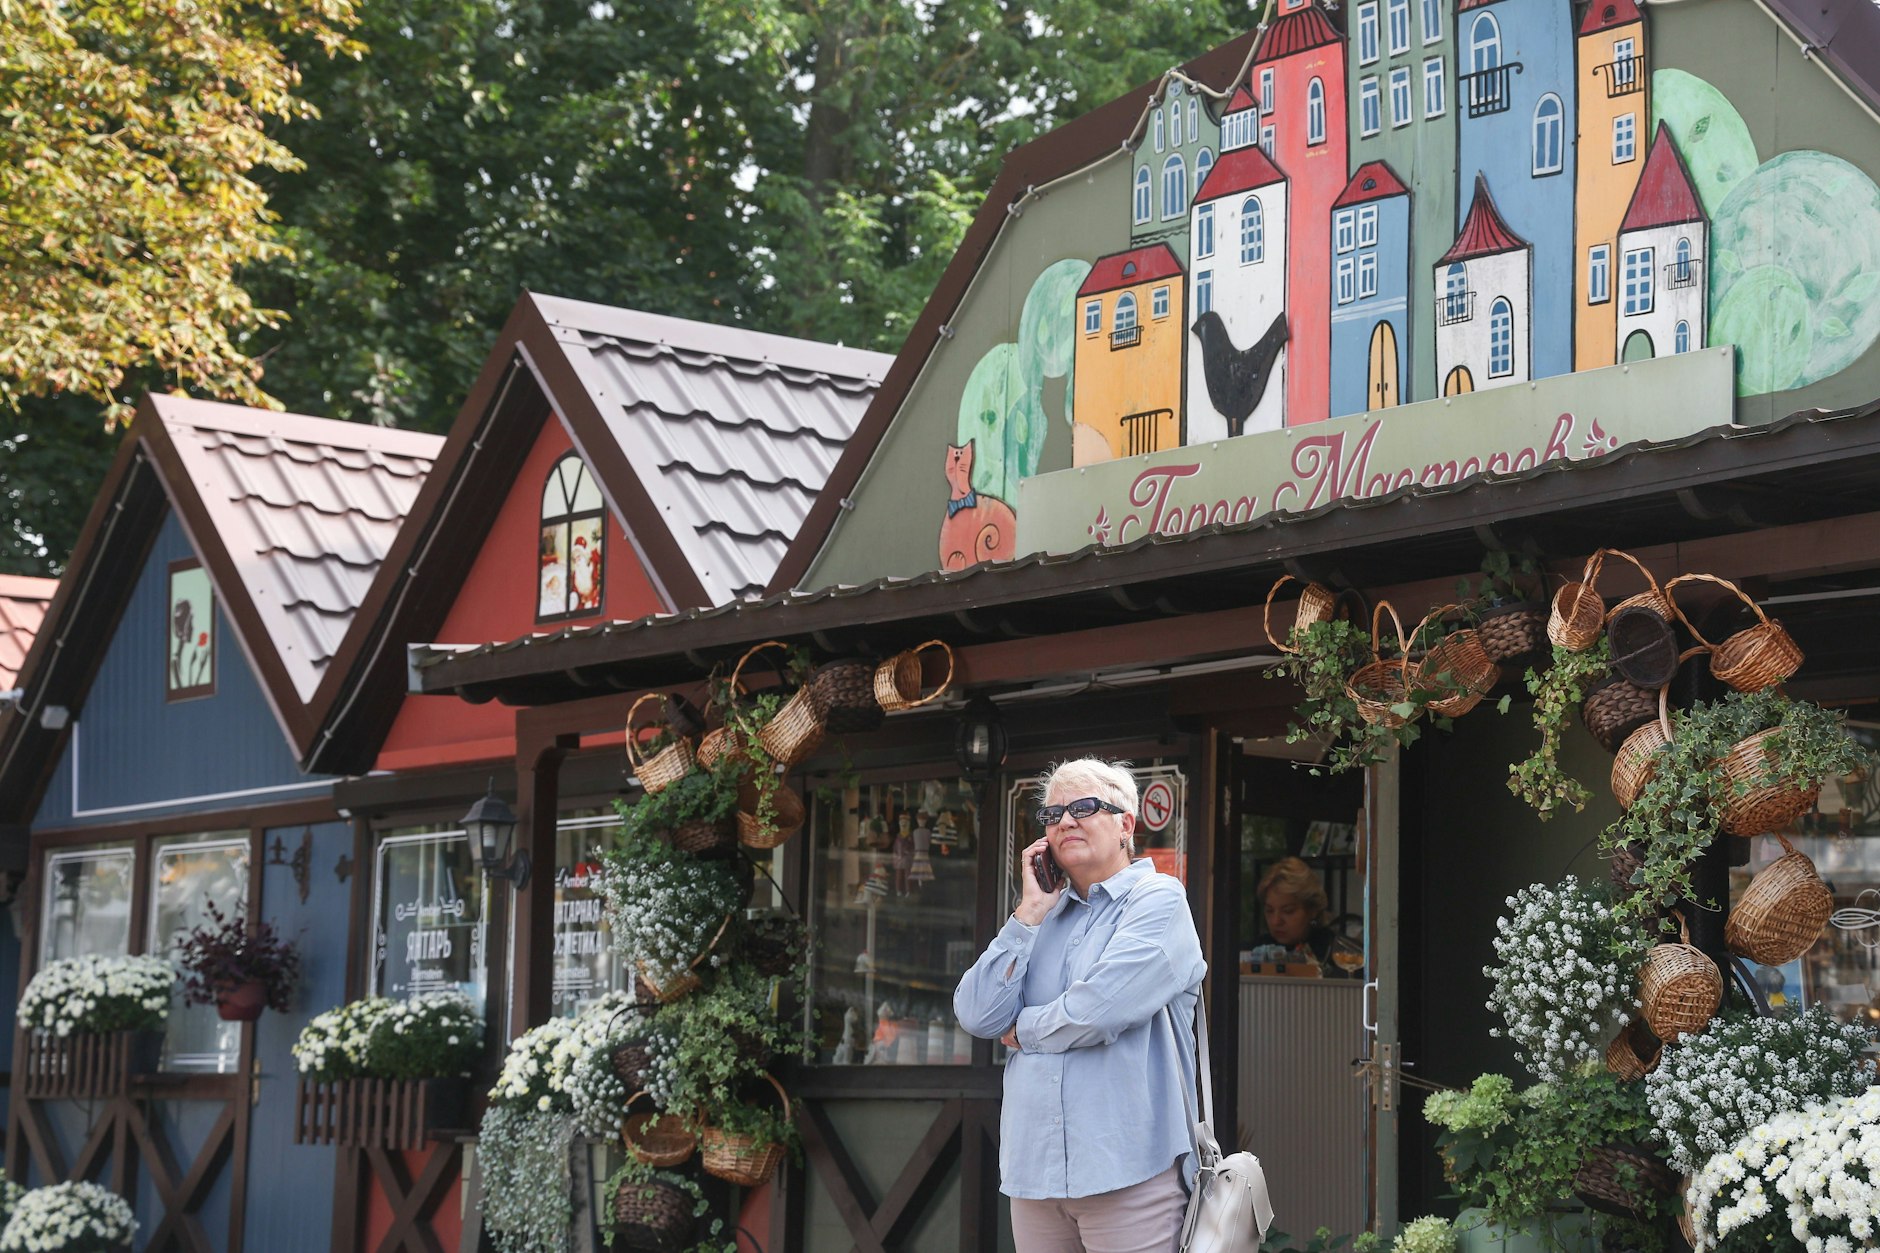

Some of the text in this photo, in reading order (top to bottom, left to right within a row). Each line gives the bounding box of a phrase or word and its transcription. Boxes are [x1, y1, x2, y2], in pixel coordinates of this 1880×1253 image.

[1118, 411, 1576, 544] Город Мастеров
[562, 873, 589, 888] Amber
[554, 899, 601, 924] НТАРНАЯ
[405, 927, 452, 964] ЯНТАРЬ
[553, 931, 603, 956] ОСМЕТИКА
